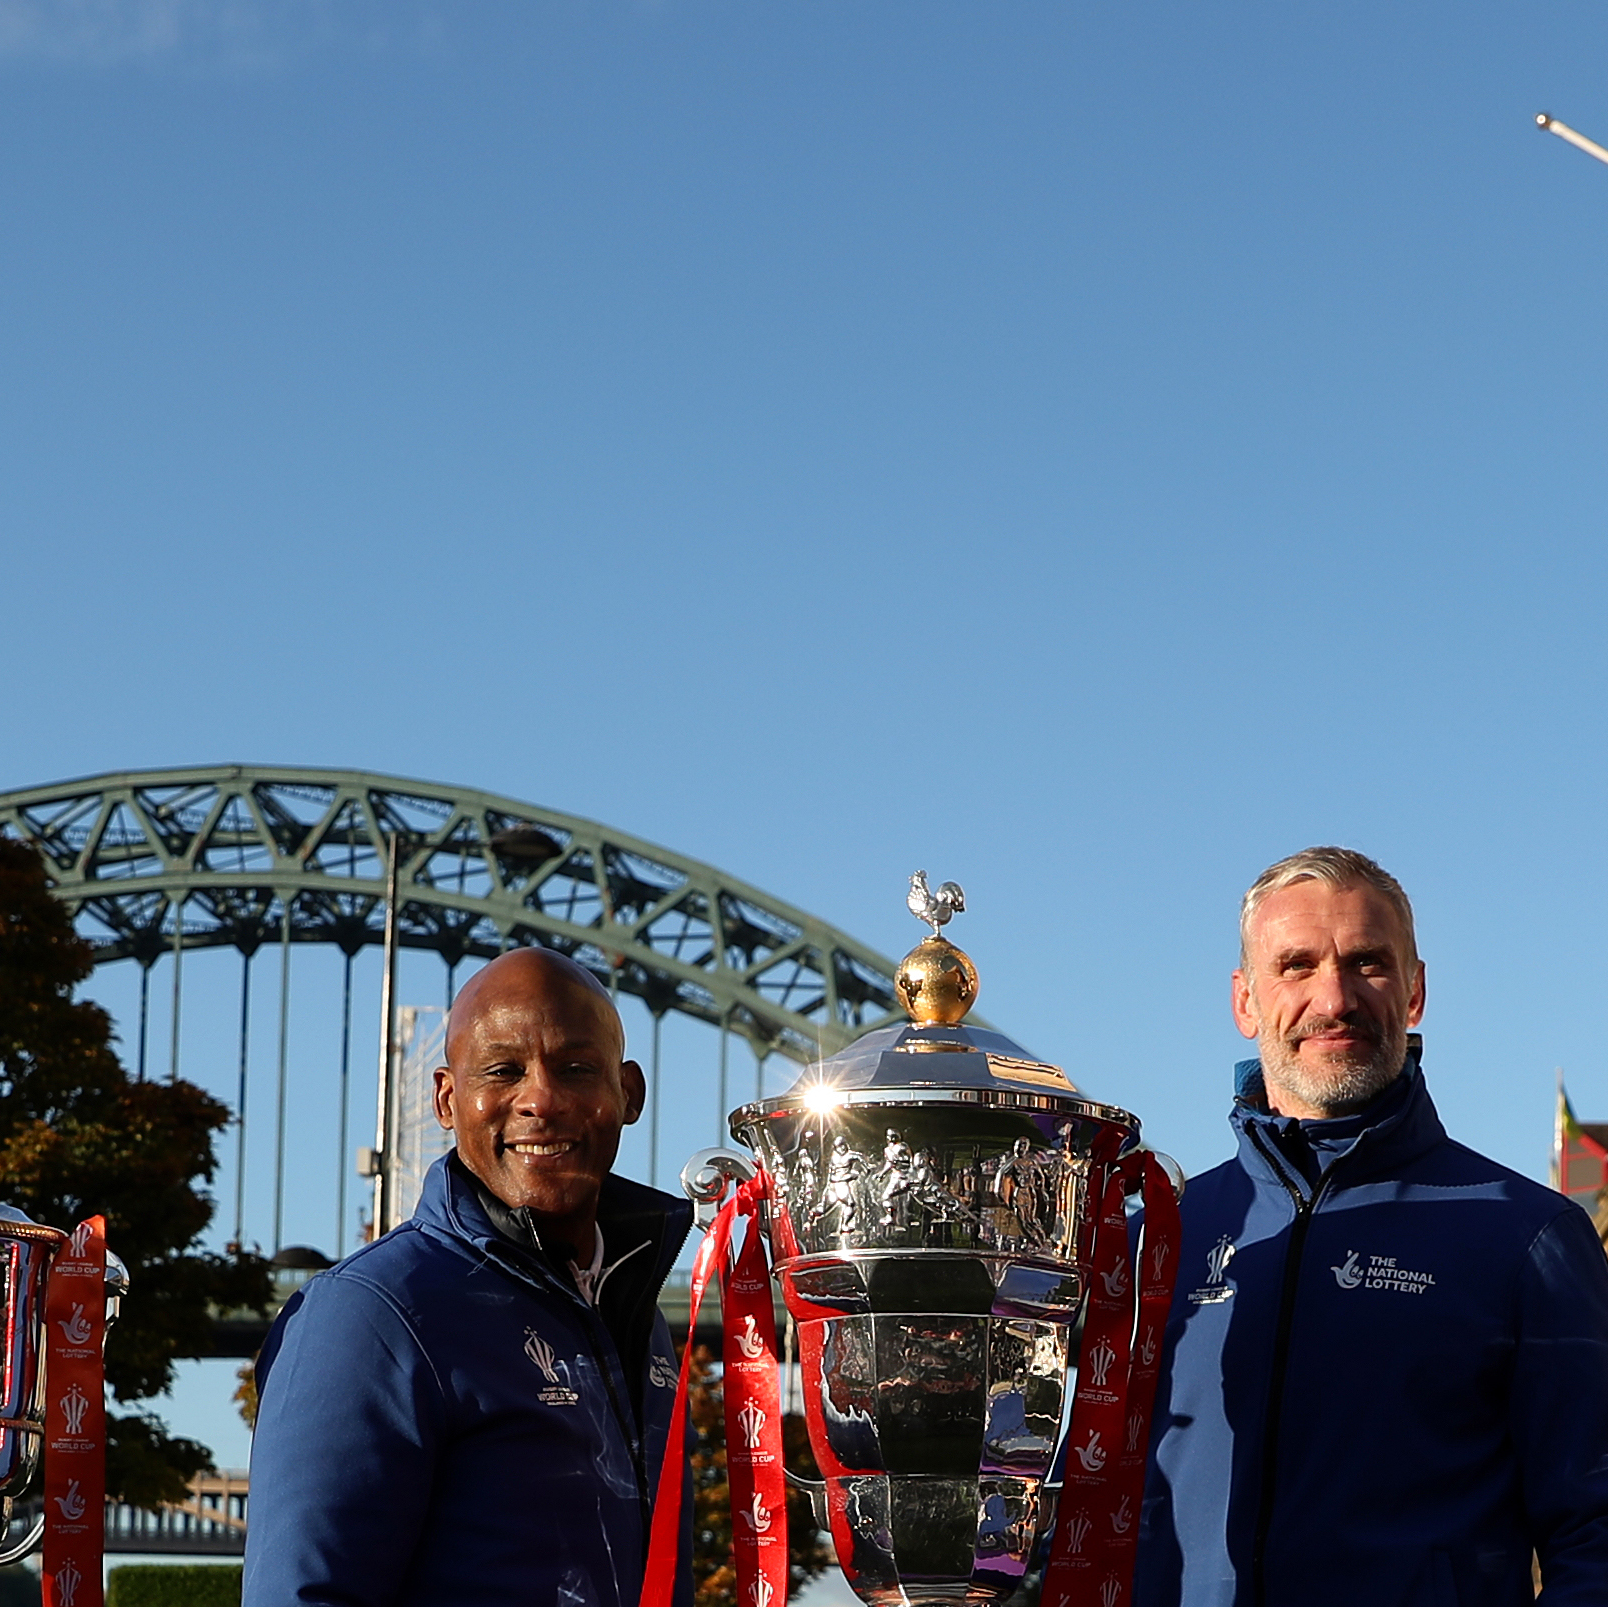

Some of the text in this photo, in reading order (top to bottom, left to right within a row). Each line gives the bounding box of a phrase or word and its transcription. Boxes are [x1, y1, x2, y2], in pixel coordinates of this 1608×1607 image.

[1369, 1255, 1397, 1268] THE
[83, 1265, 101, 1274] CUP
[1367, 1266, 1436, 1286] NATIONAL
[1365, 1278, 1427, 1295] LOTTERY
[1103, 1393, 1120, 1403] CUP
